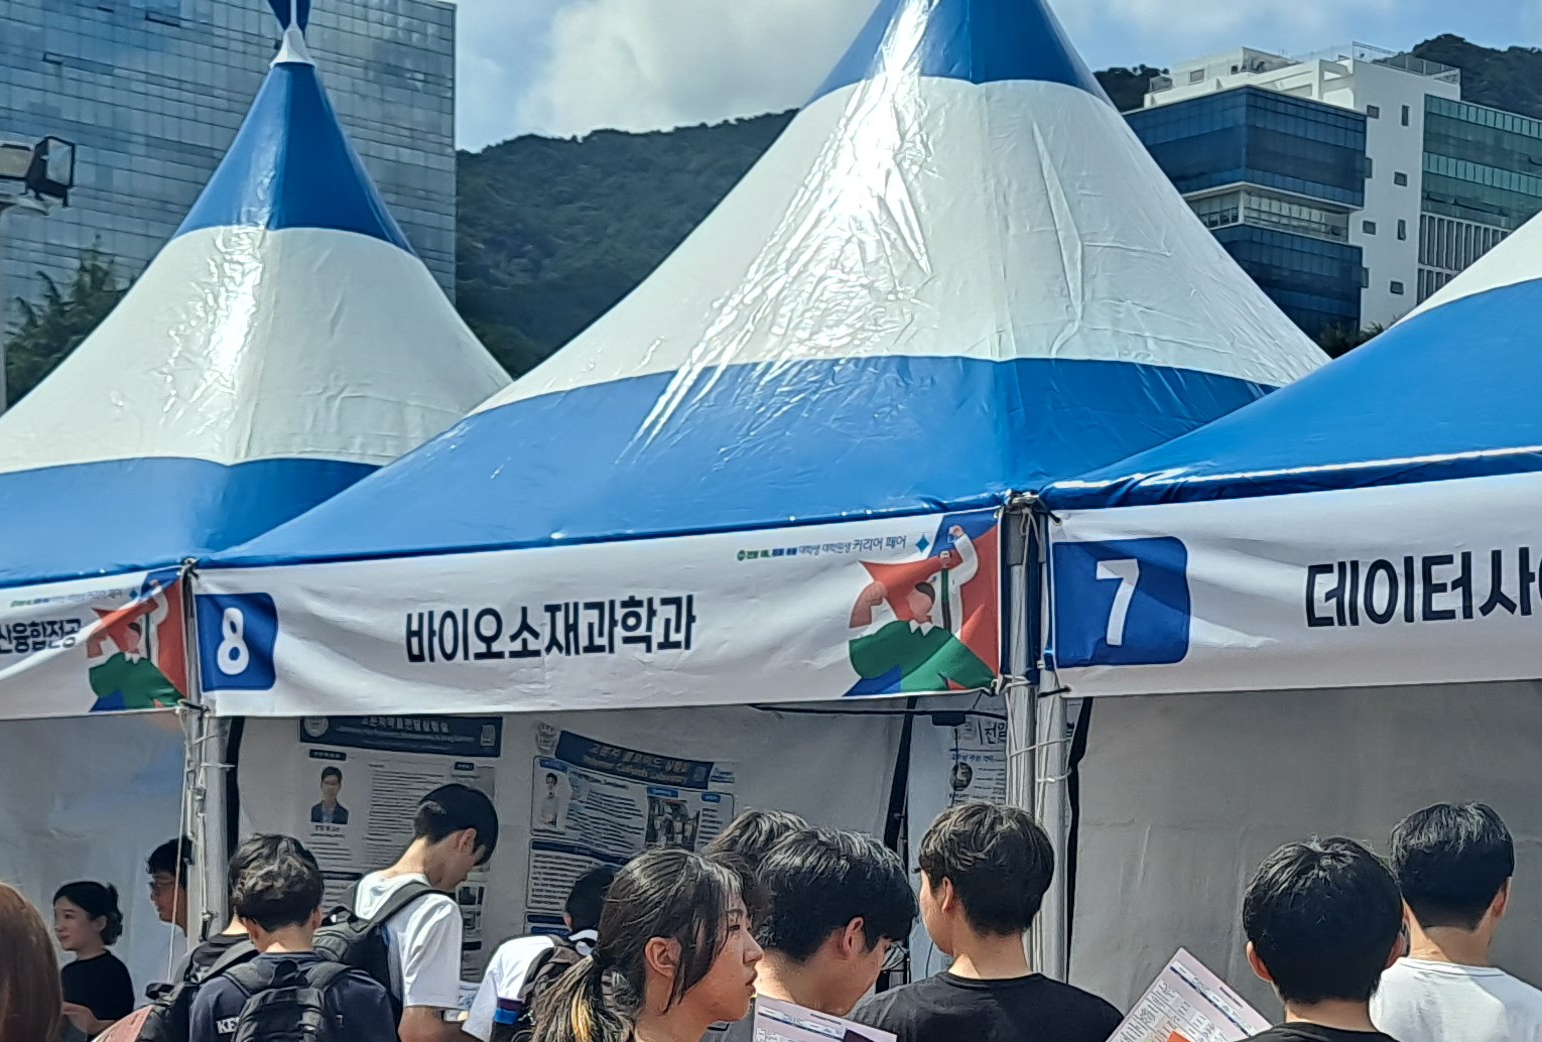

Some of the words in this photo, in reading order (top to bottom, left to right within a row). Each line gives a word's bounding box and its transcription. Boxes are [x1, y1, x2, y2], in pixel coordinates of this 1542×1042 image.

[405, 594, 698, 665] 바이오소재과학과
[1096, 558, 1140, 646] 7
[217, 606, 250, 676] 8
